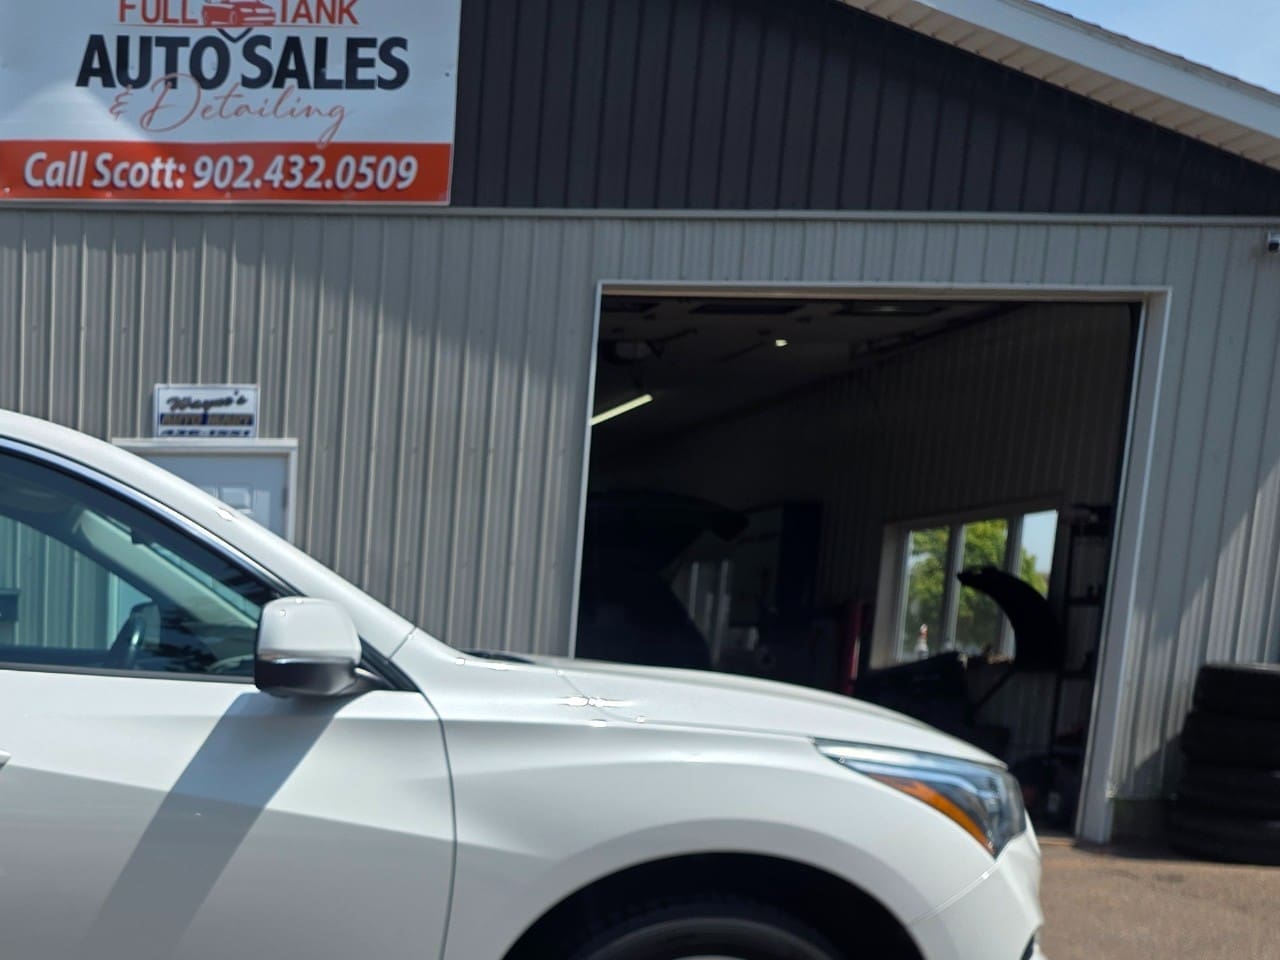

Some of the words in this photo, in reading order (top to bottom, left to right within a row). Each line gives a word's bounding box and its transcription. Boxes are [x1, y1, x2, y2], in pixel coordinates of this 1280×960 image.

[119, 0, 197, 24] FULL
[280, 0, 359, 25] TANK
[75, 34, 231, 90] AUTO
[241, 35, 411, 90] SALES
[108, 84, 133, 121] &
[139, 73, 352, 148] Detailing
[24, 151, 89, 188] Call
[94, 152, 185, 189] Scott:
[193, 155, 419, 190] 902.432.0509
